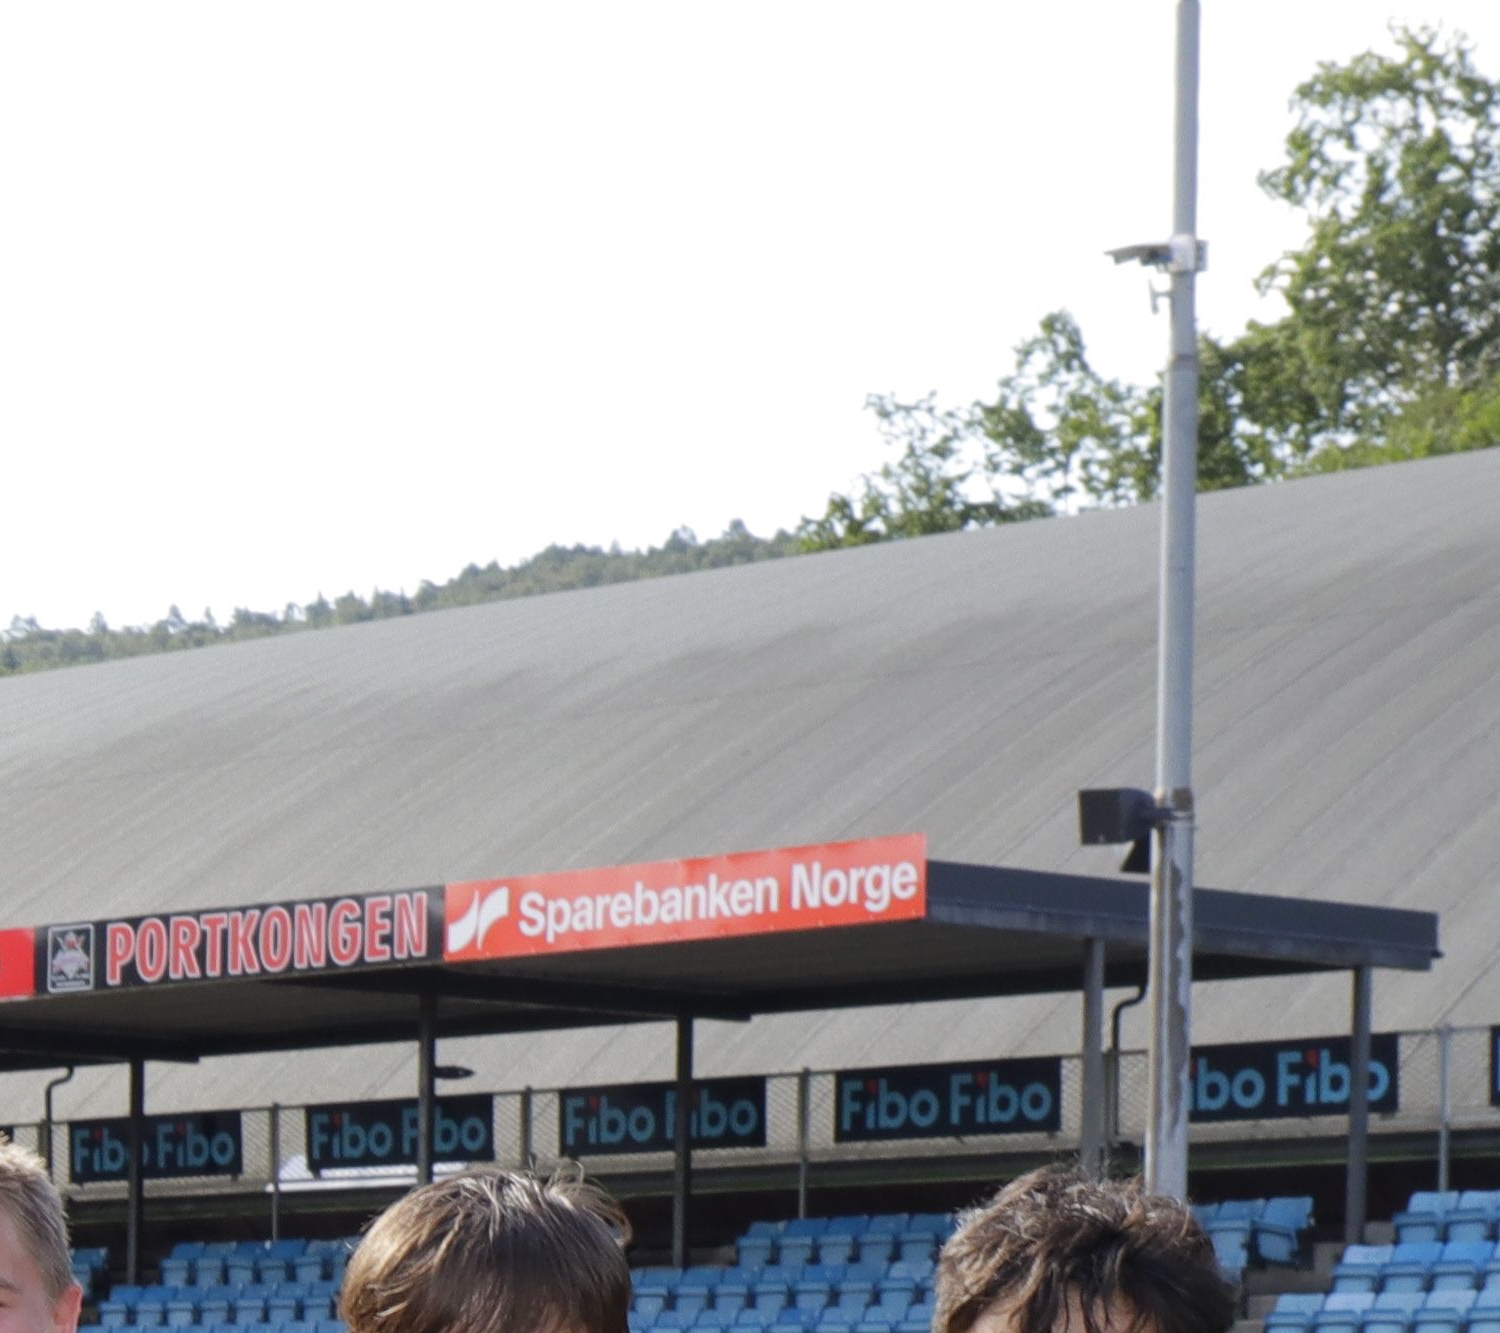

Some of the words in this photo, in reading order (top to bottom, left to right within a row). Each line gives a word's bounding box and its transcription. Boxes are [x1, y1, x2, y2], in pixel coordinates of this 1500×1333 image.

[518, 873, 780, 944] Sparebanken
[791, 857, 919, 913] Norge
[105, 890, 428, 986] PORTKONGEN
[840, 1079, 938, 1131] Fibo
[950, 1071, 1052, 1124] Fibo
[1190, 1058, 1266, 1109] ibo
[156, 1122, 235, 1168] Fibo
[312, 1112, 393, 1160] Fibo
[402, 1105, 487, 1155] Fbo
[566, 1095, 655, 1146] Fibo
